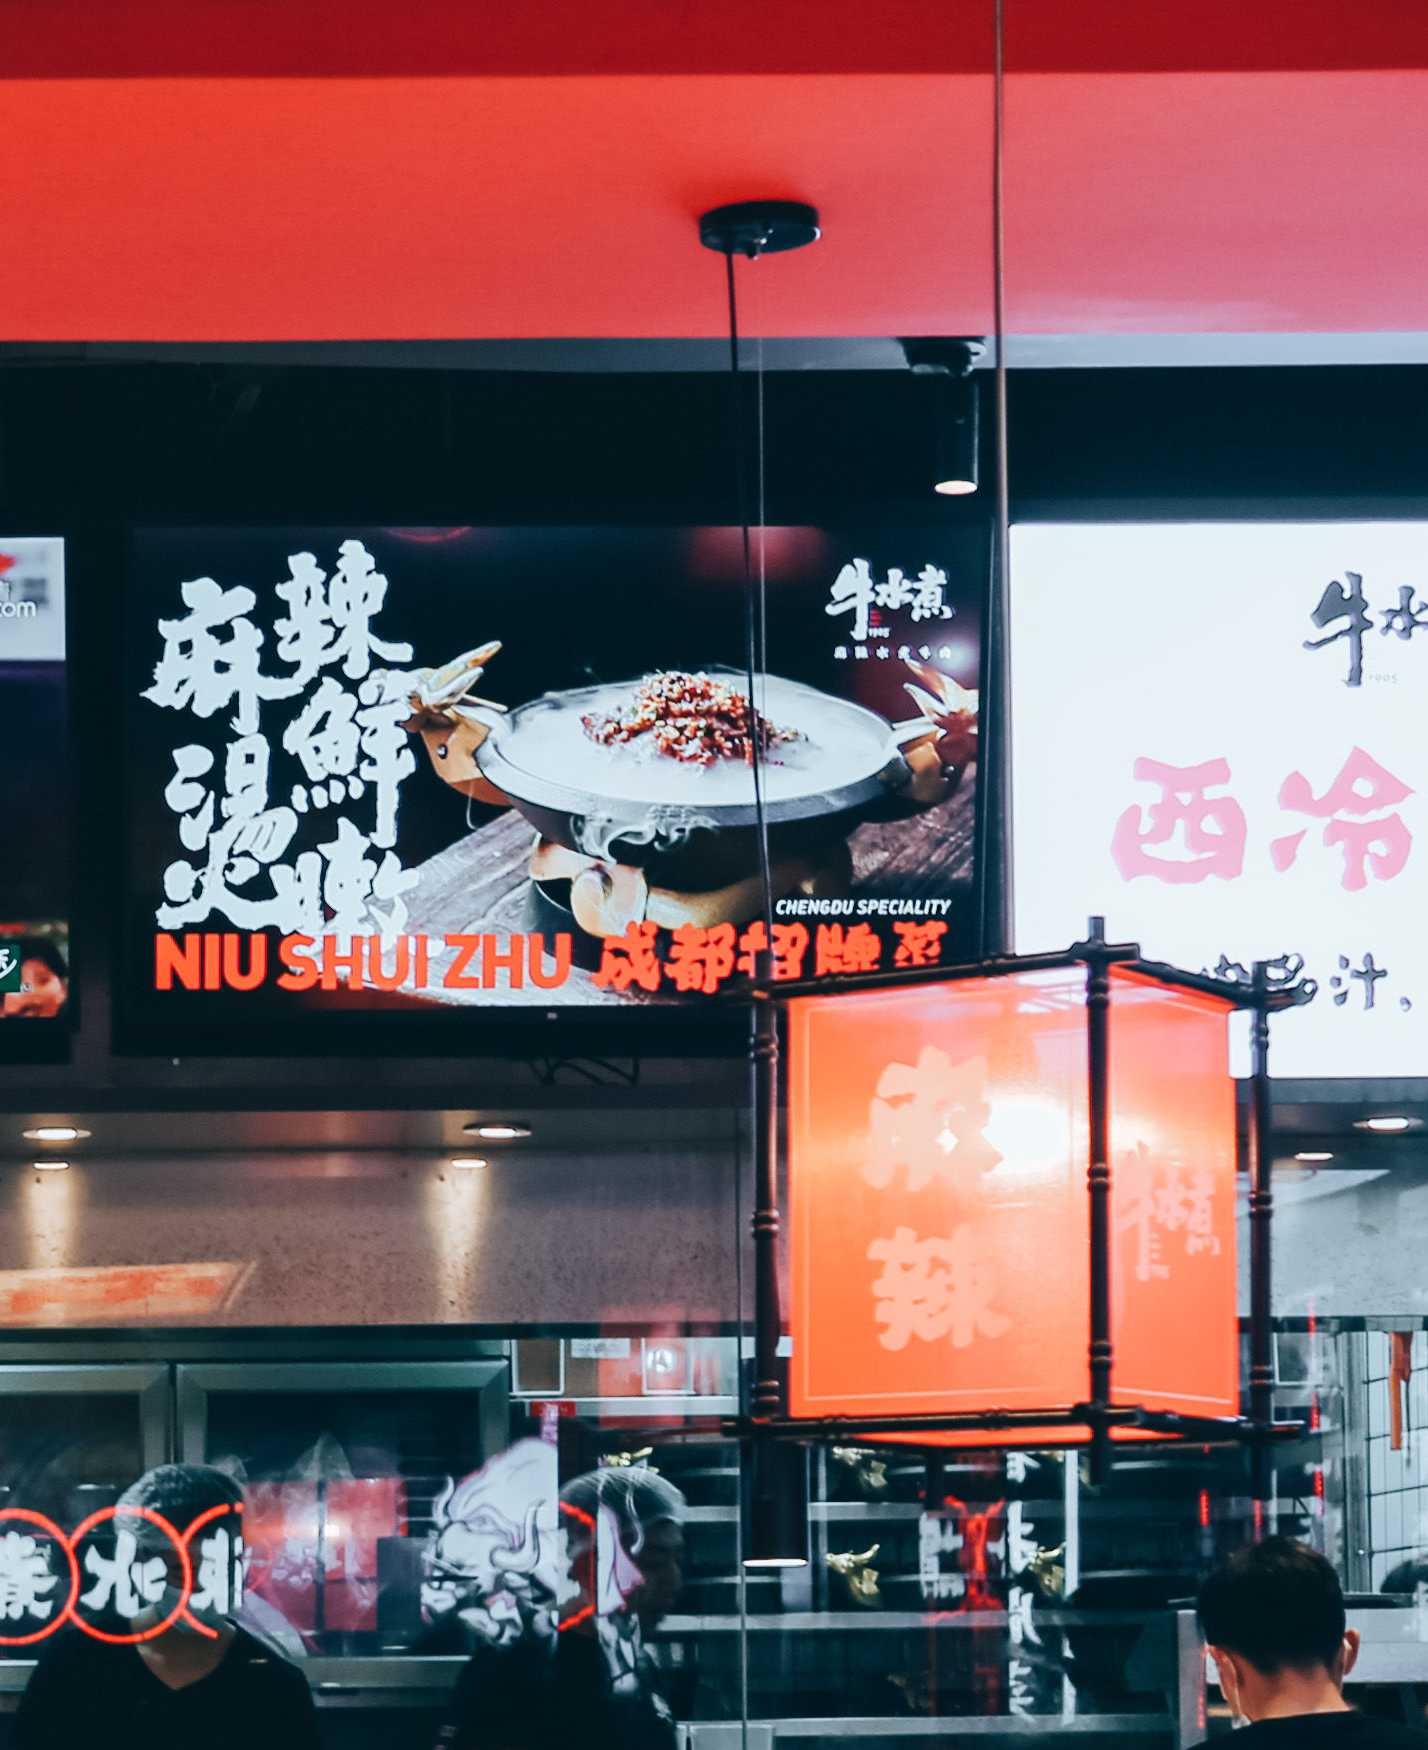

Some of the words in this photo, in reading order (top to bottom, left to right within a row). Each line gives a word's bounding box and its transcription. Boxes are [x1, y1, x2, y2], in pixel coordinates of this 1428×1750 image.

[825, 557, 954, 641] 牛水煮
[776, 899, 855, 916] CHENGDU
[857, 899, 952, 916] SPECIALITY
[155, 933, 268, 991] NIU
[278, 933, 429, 991] SHUI
[444, 932, 572, 989] ZHU
